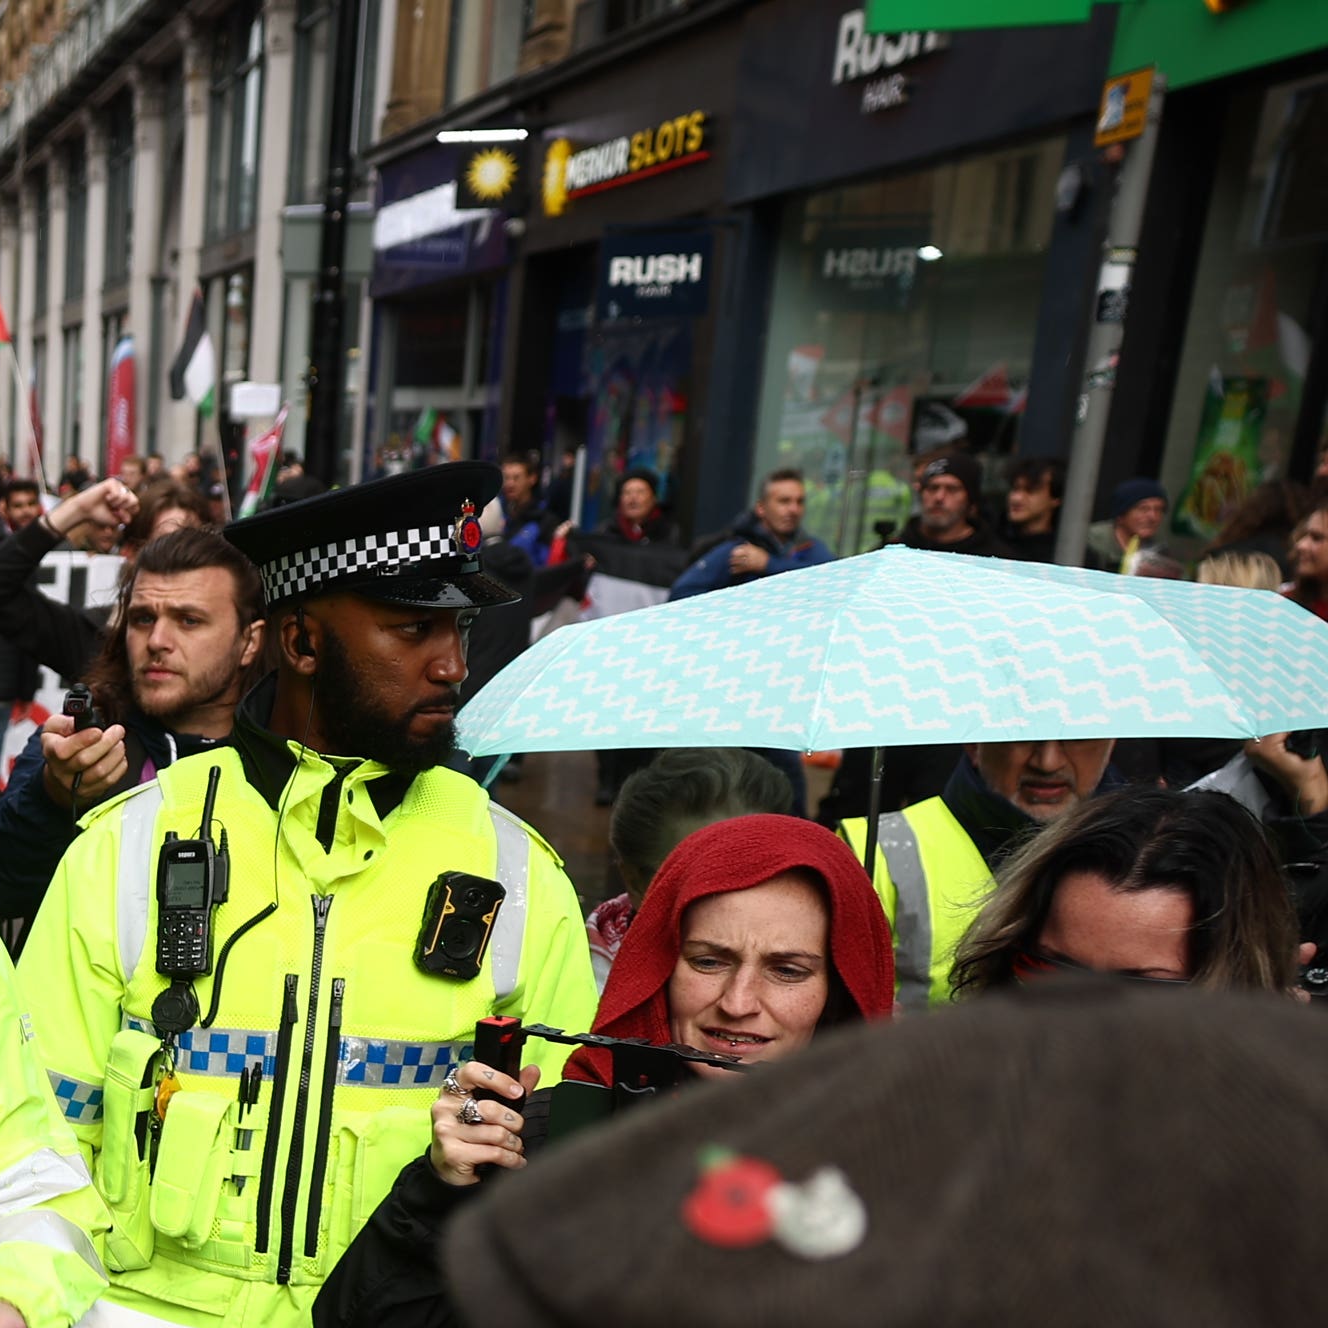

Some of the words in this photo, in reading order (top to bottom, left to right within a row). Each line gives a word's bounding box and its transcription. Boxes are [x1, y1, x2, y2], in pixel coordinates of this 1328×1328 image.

[832, 8, 940, 85] RU
[629, 111, 705, 171] SLOTS
[608, 252, 703, 287] RUSH
